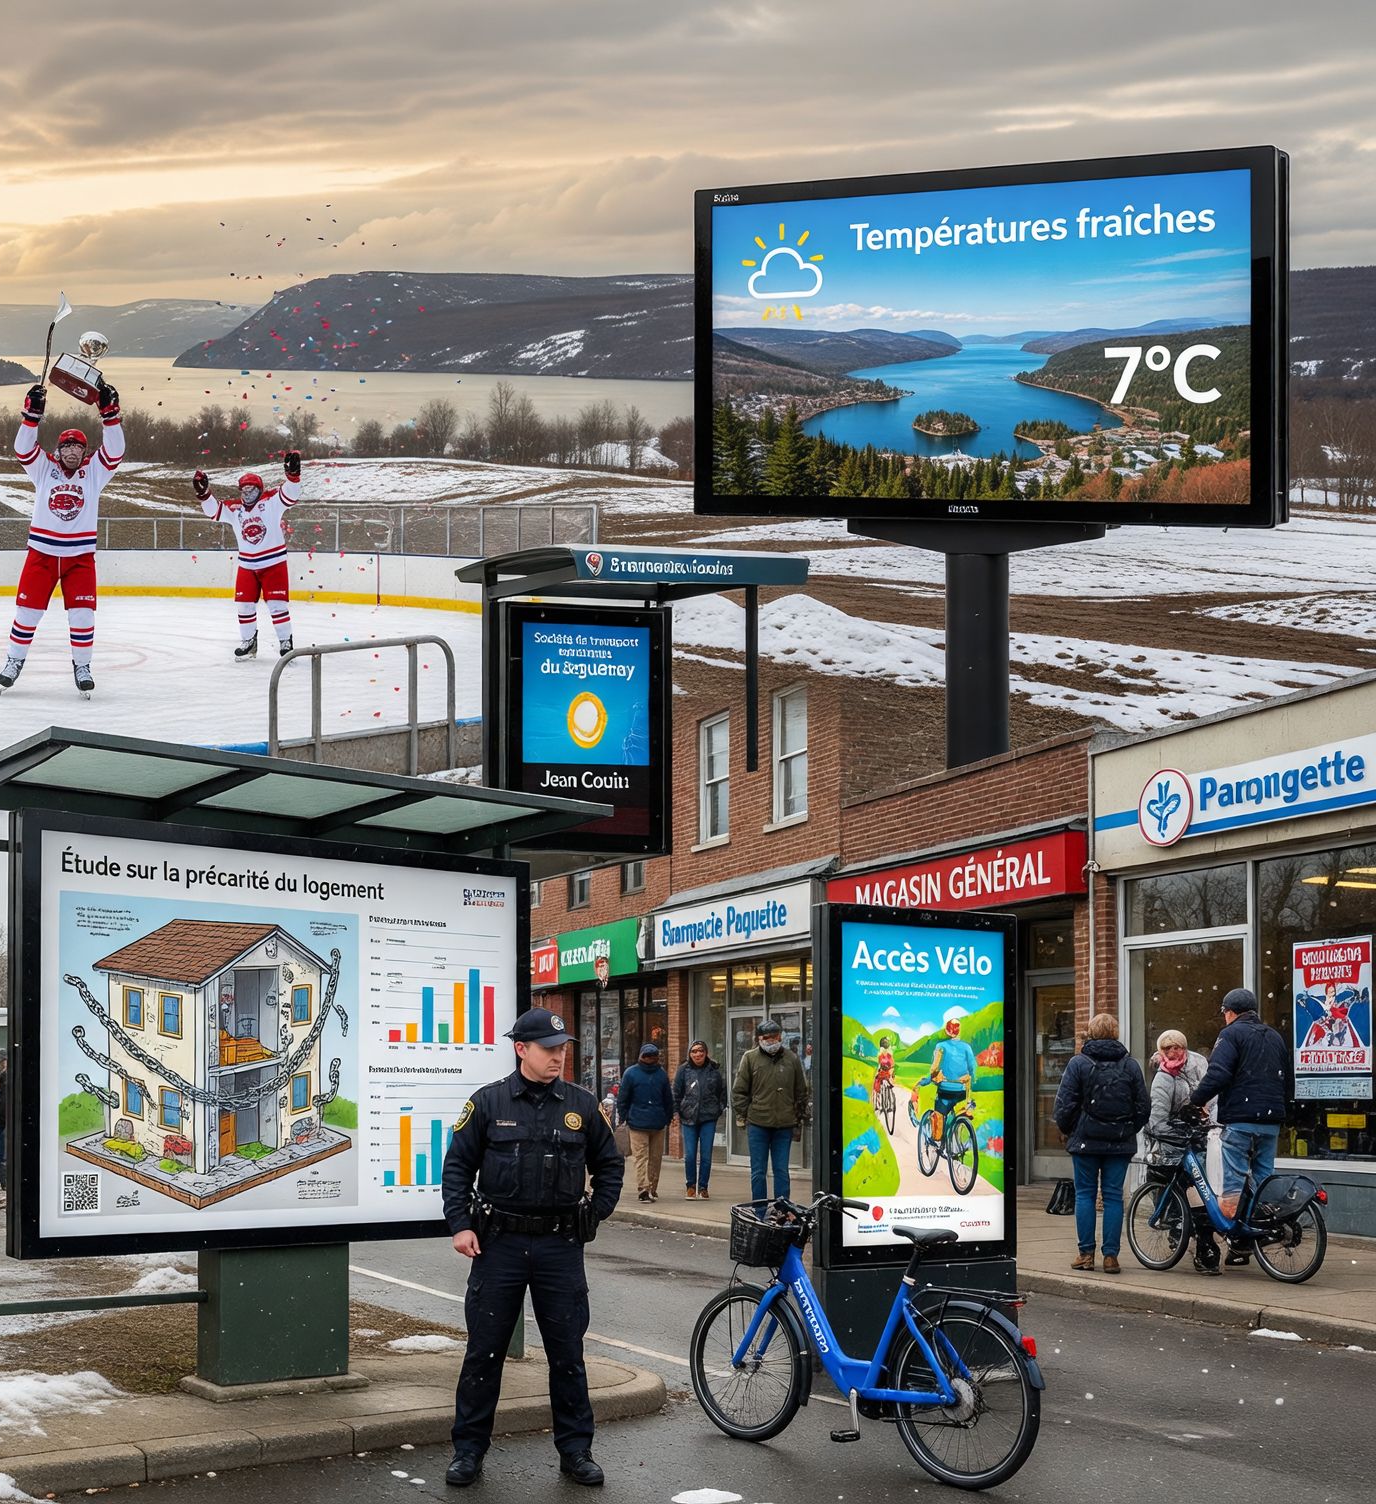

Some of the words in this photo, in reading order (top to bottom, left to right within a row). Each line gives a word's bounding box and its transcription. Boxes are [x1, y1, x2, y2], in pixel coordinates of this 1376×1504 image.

[850, 216, 1068, 255] Températures
[1077, 203, 1216, 239] fraîches
[1104, 344, 1222, 405] 7°C
[541, 658, 560, 674] du
[540, 769, 578, 788] Jean
[61, 846, 121, 877] Étude
[126, 861, 158, 880] sur
[163, 861, 180, 882] la
[185, 863, 270, 889] précarité
[274, 872, 297, 893] du
[303, 873, 385, 901] logement
[855, 871, 941, 907] MAGASIN
[948, 850, 1052, 900] GÉNÉRAL
[851, 940, 930, 973] Accès
[935, 946, 992, 976] Vélo
